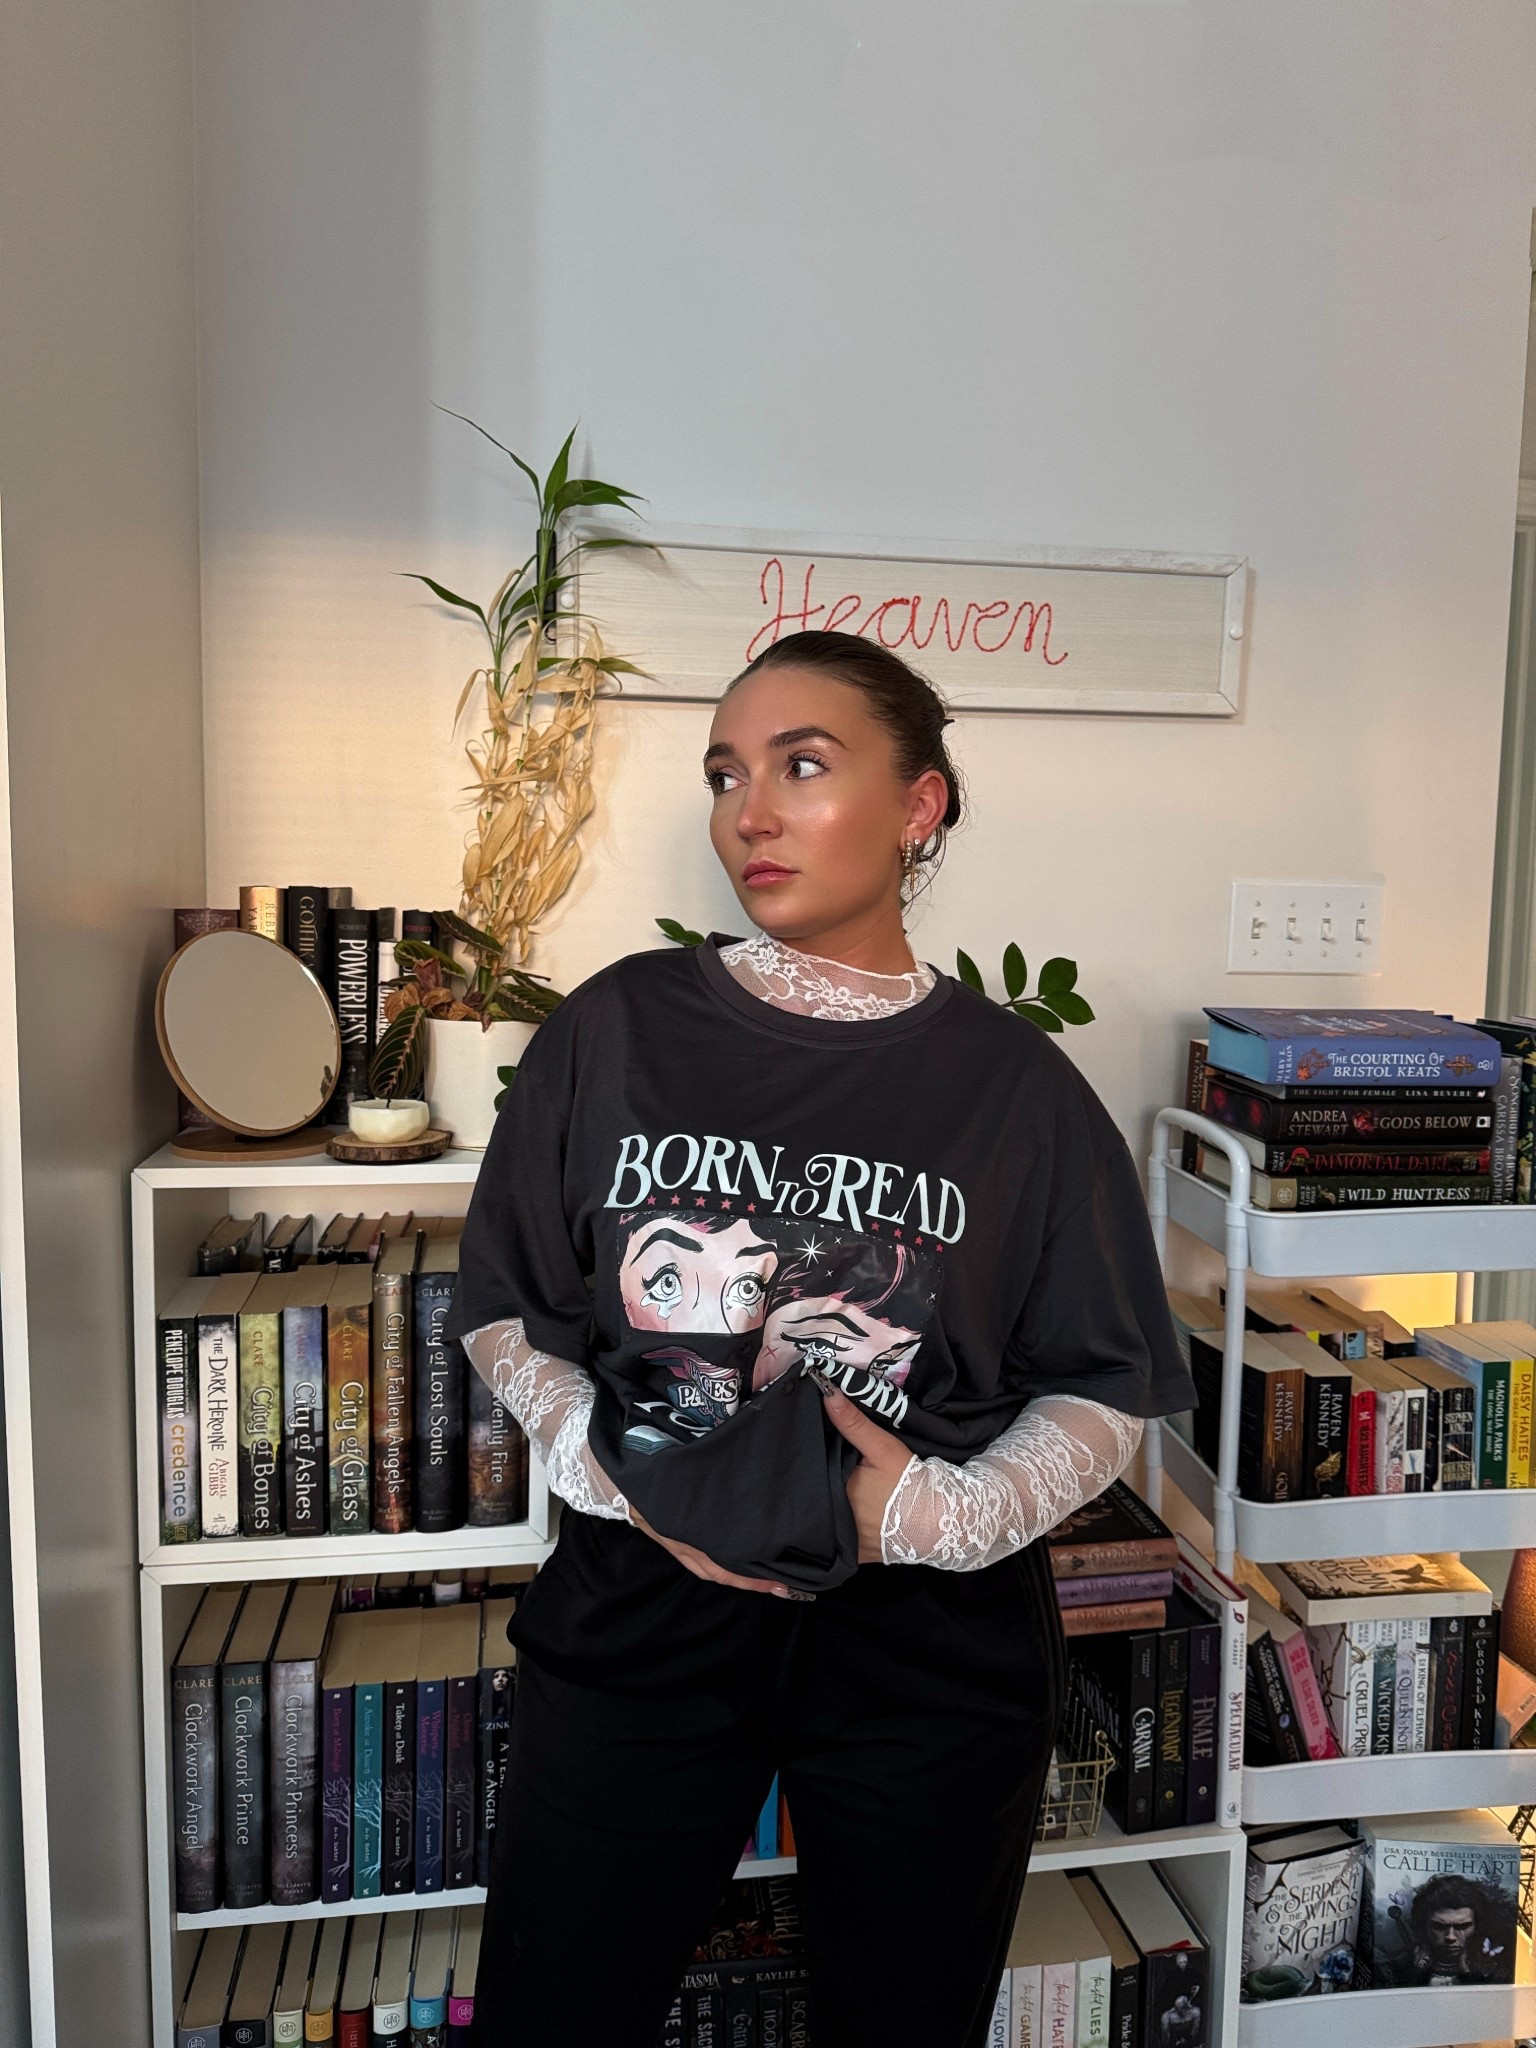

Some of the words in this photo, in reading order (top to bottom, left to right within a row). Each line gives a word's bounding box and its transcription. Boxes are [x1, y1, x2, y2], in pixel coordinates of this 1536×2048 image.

[747, 558, 1068, 666] Heaven
[337, 938, 368, 1045] POWERLESS
[1276, 1059, 1286, 1082] MARY
[1283, 1045, 1293, 1084] PEARSON
[1333, 1066, 1393, 1078] BRISTOL
[1396, 1066, 1441, 1078] KEATS
[1350, 1053, 1426, 1066] COURTING
[1313, 1089, 1341, 1097] FIGHT
[1342, 1089, 1360, 1097] FOR
[1362, 1089, 1397, 1097] FEMALE
[1405, 1089, 1428, 1098] LISA
[1288, 1124, 1349, 1137] STEWART
[1291, 1110, 1347, 1123] ANDREA
[1379, 1116, 1421, 1129] GODS
[1425, 1116, 1473, 1129] BELOW
[1496, 1095, 1508, 1143] CARISSA
[1314, 1153, 1402, 1171] IMMORTAL
[603, 1133, 786, 1209] BORN
[771, 1179, 820, 1216] TO
[805, 1153, 966, 1245] READ
[1347, 1188, 1386, 1201] WILD
[1391, 1187, 1471, 1201] HUNTRESS
[212, 1337, 223, 1355] THE
[342, 1325, 353, 1361] CLARE
[383, 1313, 404, 1351] City
[426, 1307, 449, 1347] City
[165, 1329, 183, 1375] PENELOPE
[253, 1330, 264, 1367] CLARE
[385, 1356, 404, 1369] of
[429, 1351, 449, 1366] of
[207, 1356, 229, 1399] DARK
[430, 1371, 449, 1410] Lost
[1520, 1373, 1532, 1412] DAISY
[166, 1376, 185, 1419] DOUGLAS
[246, 1387, 274, 1436] City
[288, 1381, 317, 1428] City
[334, 1381, 365, 1432] City
[388, 1376, 405, 1434] Fallen
[1273, 1382, 1285, 1443] KENNEDY
[1284, 1391, 1295, 1432] RAVEN
[1317, 1383, 1332, 1449] KENNEDY
[1330, 1393, 1344, 1438] RAVEN
[1486, 1401, 1494, 1419] LONG
[1494, 1379, 1506, 1430] MAGNOLIA
[206, 1399, 229, 1452] HEROINE
[293, 1433, 316, 1453] of
[430, 1415, 449, 1466] Souls
[1485, 1435, 1493, 1454] HOME
[1486, 1420, 1494, 1434] WAY
[1517, 1416, 1531, 1462] HAITES
[250, 1438, 272, 1457] of
[341, 1436, 363, 1456] of
[383, 1435, 404, 1494] Angels
[1493, 1431, 1504, 1462] PARKS
[171, 1424, 188, 1518] credence
[208, 1463, 219, 1497] GIBBS
[215, 1458, 230, 1500] ABIGAIL
[490, 1451, 508, 1483] Fire
[254, 1463, 276, 1529] Bones
[295, 1456, 317, 1520] Ashes
[341, 1460, 365, 1521] Glass
[1077, 1608, 1132, 1620] STEPHANIE
[174, 1677, 215, 1690] CLARE
[223, 1675, 263, 1687] CLARE
[1417, 1667, 1427, 1690] KING
[1473, 1638, 1487, 1705] CROOKED
[394, 1702, 406, 1731] Taken
[1355, 1680, 1369, 1724] CRUEL
[1376, 1678, 1393, 1732] WICKED
[1397, 1676, 1412, 1719] QUEEN
[1416, 1691, 1426, 1703] OF
[234, 1695, 253, 1788] Clockwork
[285, 1694, 303, 1786] Clockwork
[364, 1707, 374, 1737] Awake
[430, 1709, 442, 1749] Whispers
[486, 1721, 510, 1731] ZINK
[1131, 1706, 1156, 1774] CARAVAL
[1160, 1689, 1185, 1763] LEGENDARY
[1191, 1695, 1217, 1761] FINALE
[1228, 1691, 1243, 1772] SPECTACULAR
[184, 1703, 203, 1797] Clockwork
[395, 1740, 405, 1764] Dusk
[486, 1760, 495, 1775] OF
[235, 1792, 254, 1846] Prince
[484, 1778, 498, 1830] ANGELS
[181, 1801, 204, 1853] Angel
[285, 1791, 303, 1859] Princess
[1383, 1854, 1455, 1874] CALLIE
[1461, 1859, 1518, 1875] HART
[1402, 1848, 1428, 1857] TODAY
[1484, 1852, 1518, 1861] AUTHOR
[1265, 1903, 1283, 1924] &
[1304, 1891, 1358, 1921] WINGS
[1284, 1867, 1360, 1913] SERPENT
[1278, 1917, 1353, 1955] NIGHT
[755, 1970, 796, 1983] KAYLIE
[697, 1994, 712, 2018] THE
[1090, 2007, 1102, 2036] LIES
[1121, 2014, 1132, 2040] Pride
